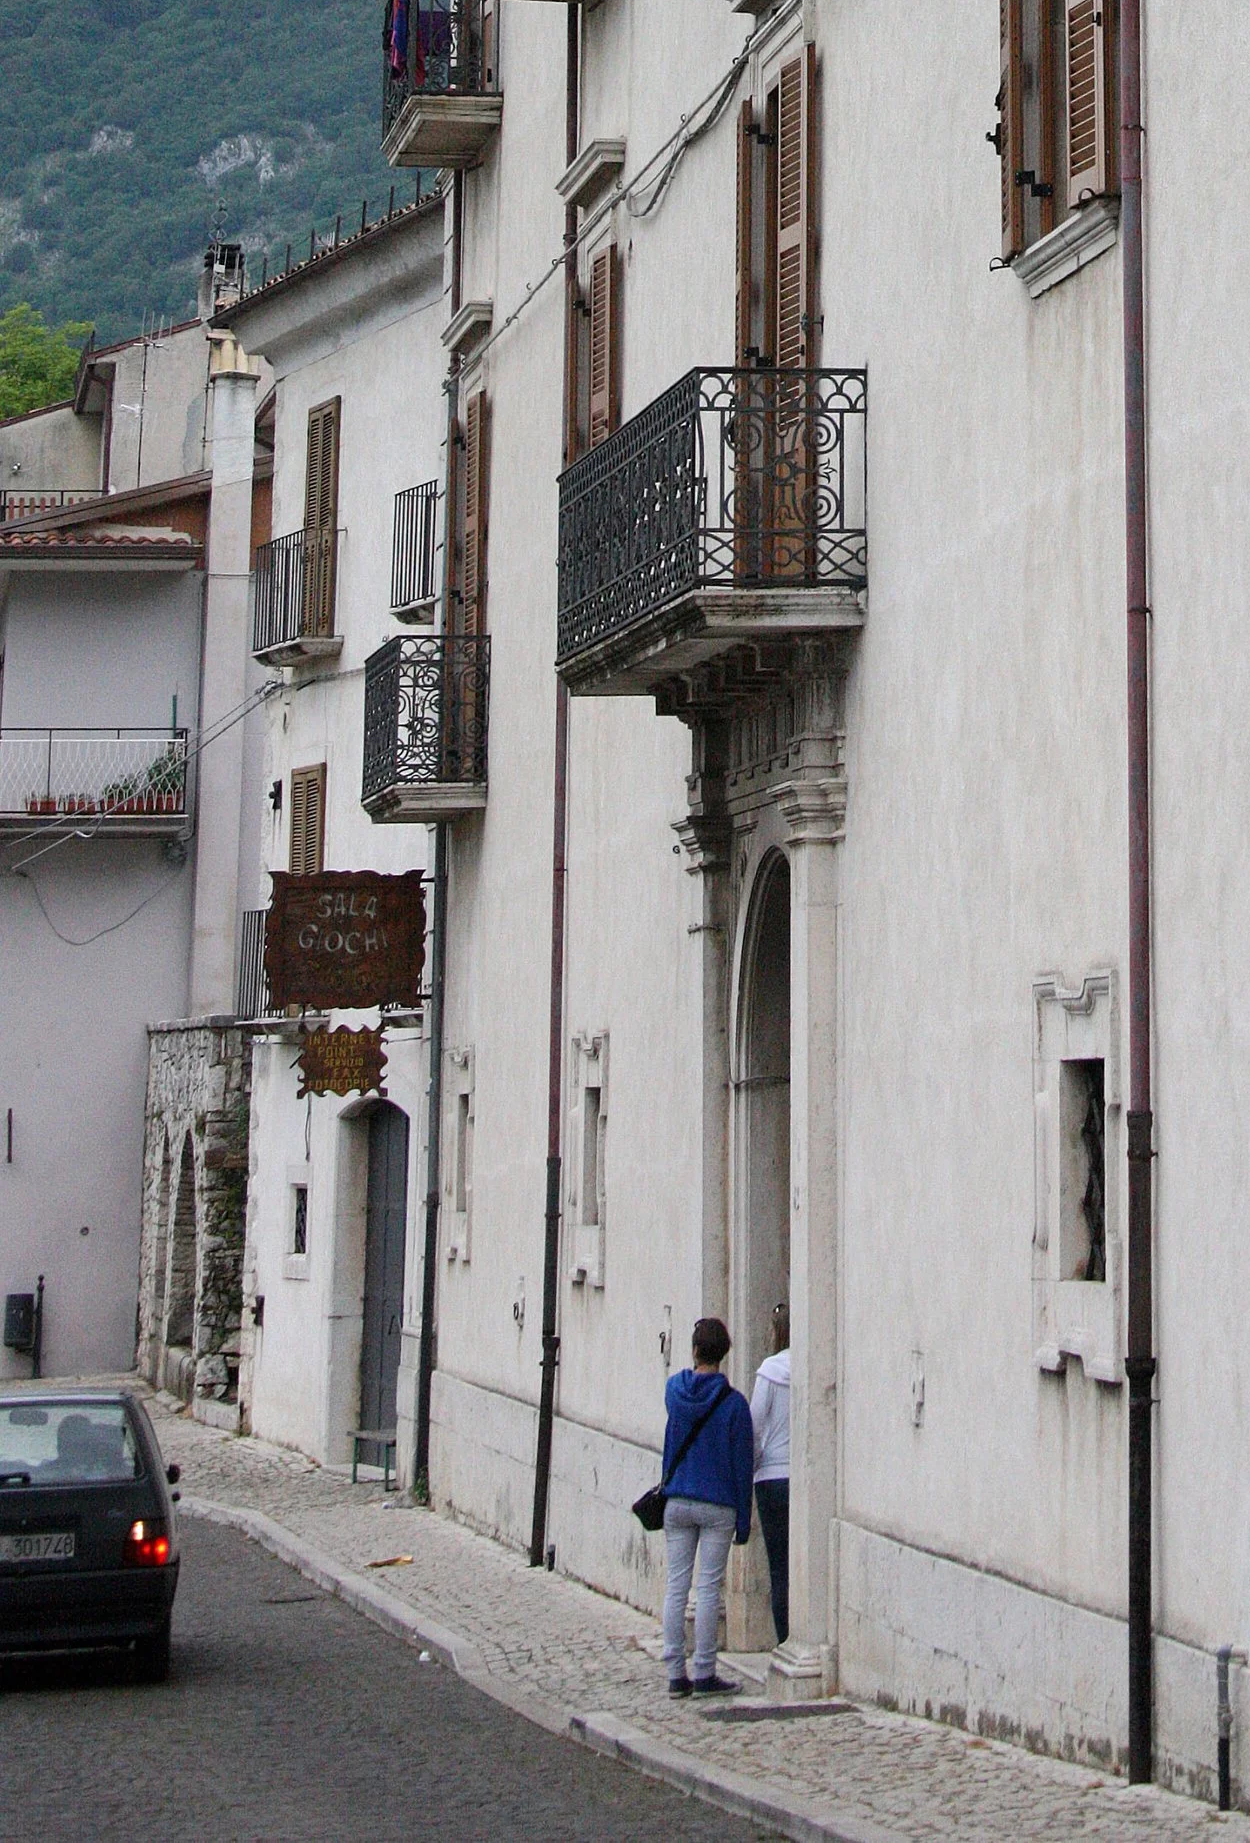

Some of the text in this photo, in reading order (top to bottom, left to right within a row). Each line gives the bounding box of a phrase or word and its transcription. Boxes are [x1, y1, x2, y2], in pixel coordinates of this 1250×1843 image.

[315, 892, 379, 920] SALA
[298, 923, 388, 955] GIOCHI
[308, 1032, 377, 1046] INTERNET
[317, 1045, 357, 1058] POINT
